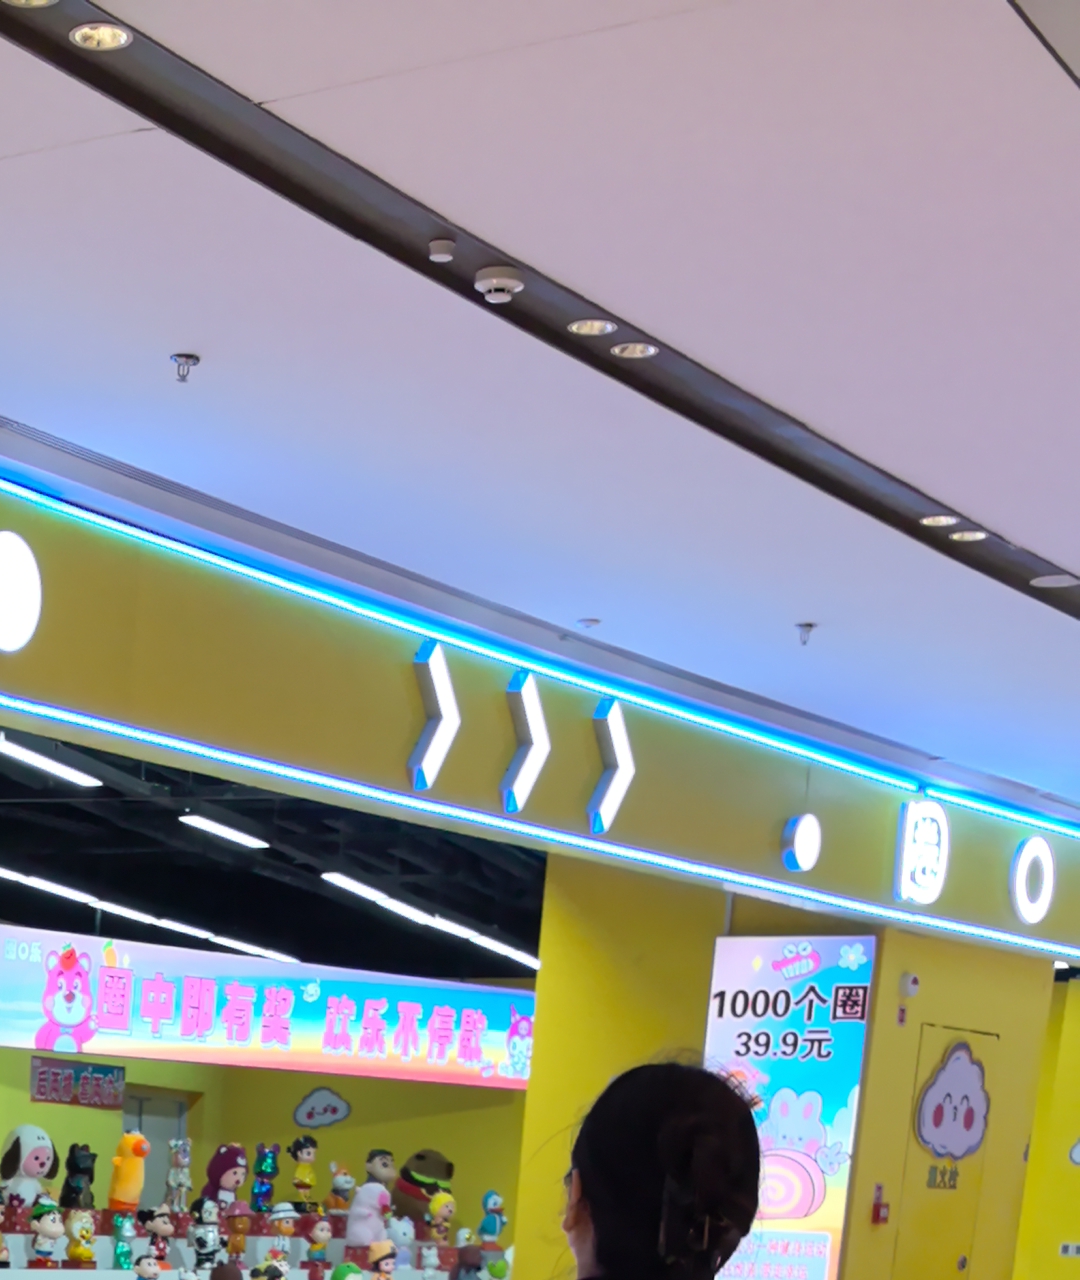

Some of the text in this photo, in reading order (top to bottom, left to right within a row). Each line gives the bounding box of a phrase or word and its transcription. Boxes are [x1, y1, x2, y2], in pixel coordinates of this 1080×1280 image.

[97, 966, 488, 1068] 圈中即有奖 欢乐不停歇
[713, 985, 869, 1022] 1000个圈
[734, 1029, 832, 1060] 39.9元
